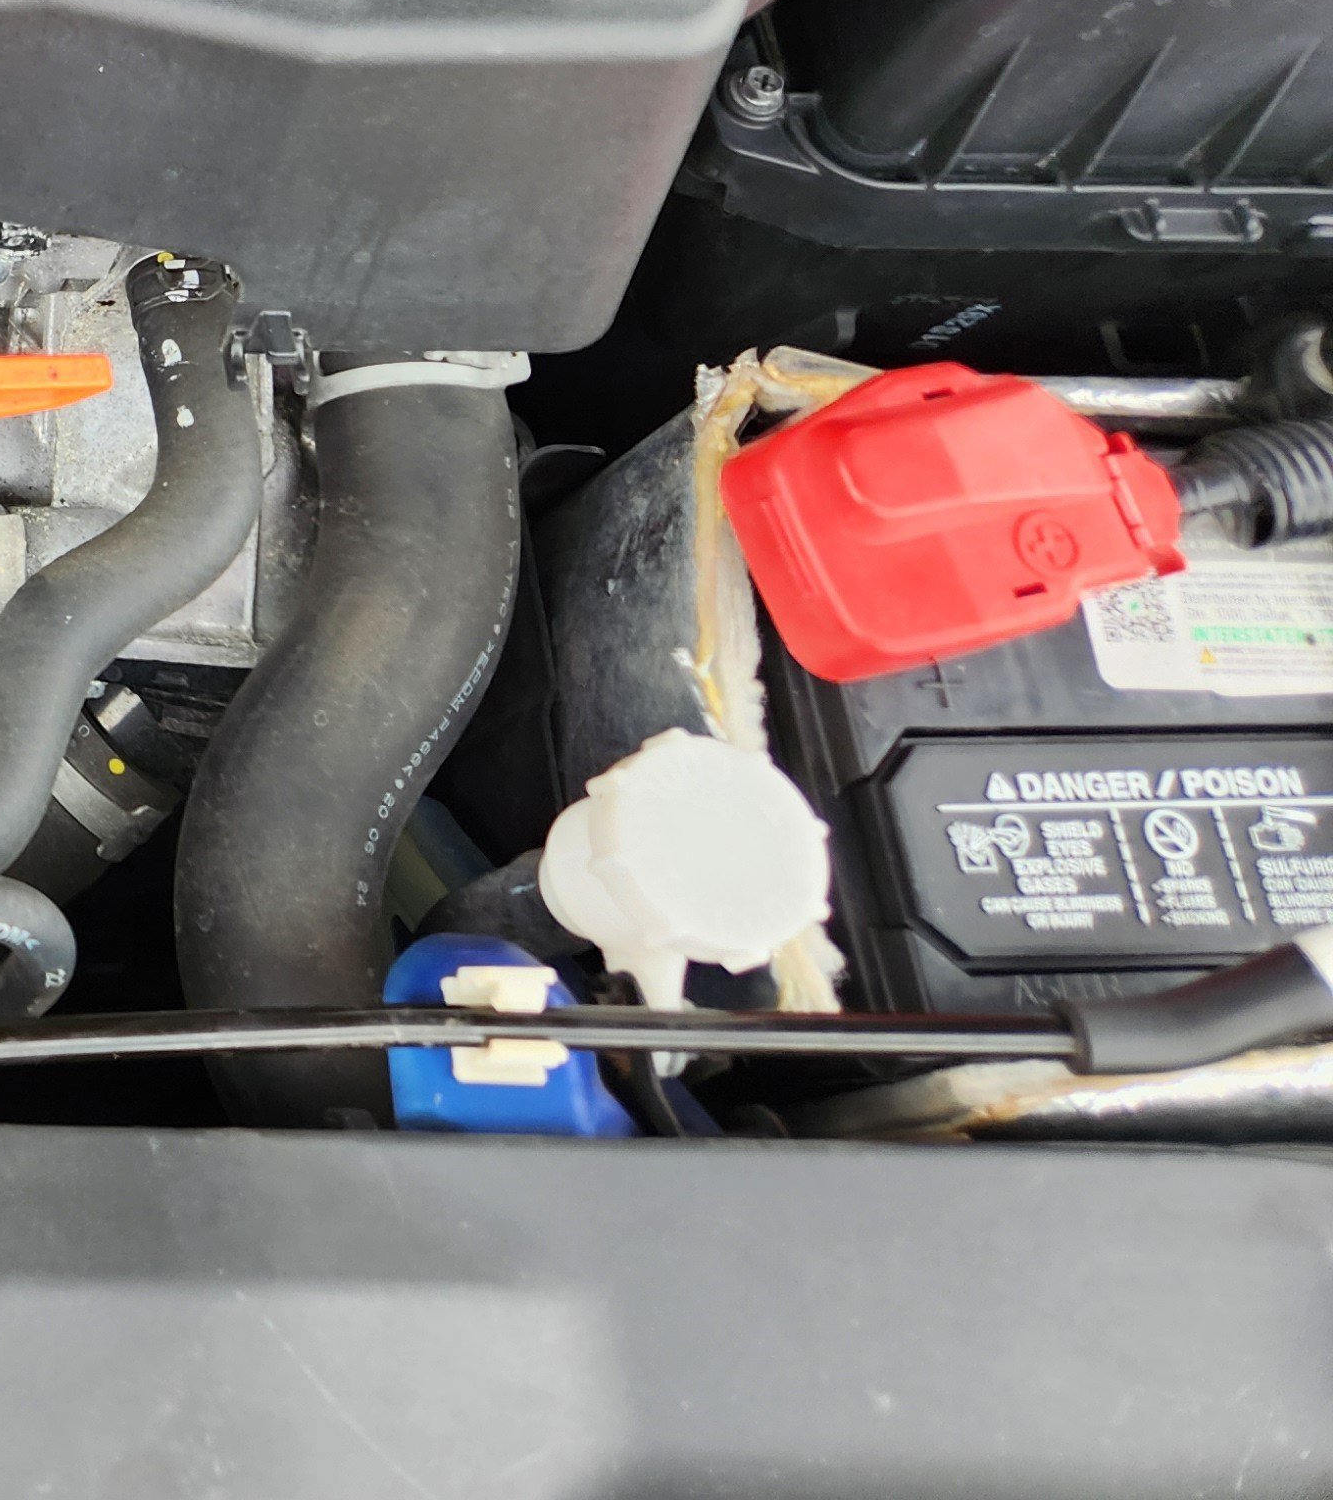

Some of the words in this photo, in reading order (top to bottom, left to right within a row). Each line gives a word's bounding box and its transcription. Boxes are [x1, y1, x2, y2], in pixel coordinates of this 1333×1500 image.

[1015, 770, 1153, 801] DANGER
[1180, 766, 1306, 798] POISON
[1040, 820, 1104, 840] SHIELD
[1011, 856, 1109, 878] EXPLOSIVE
[1166, 861, 1195, 878] NO
[1017, 876, 1079, 896] GASES
